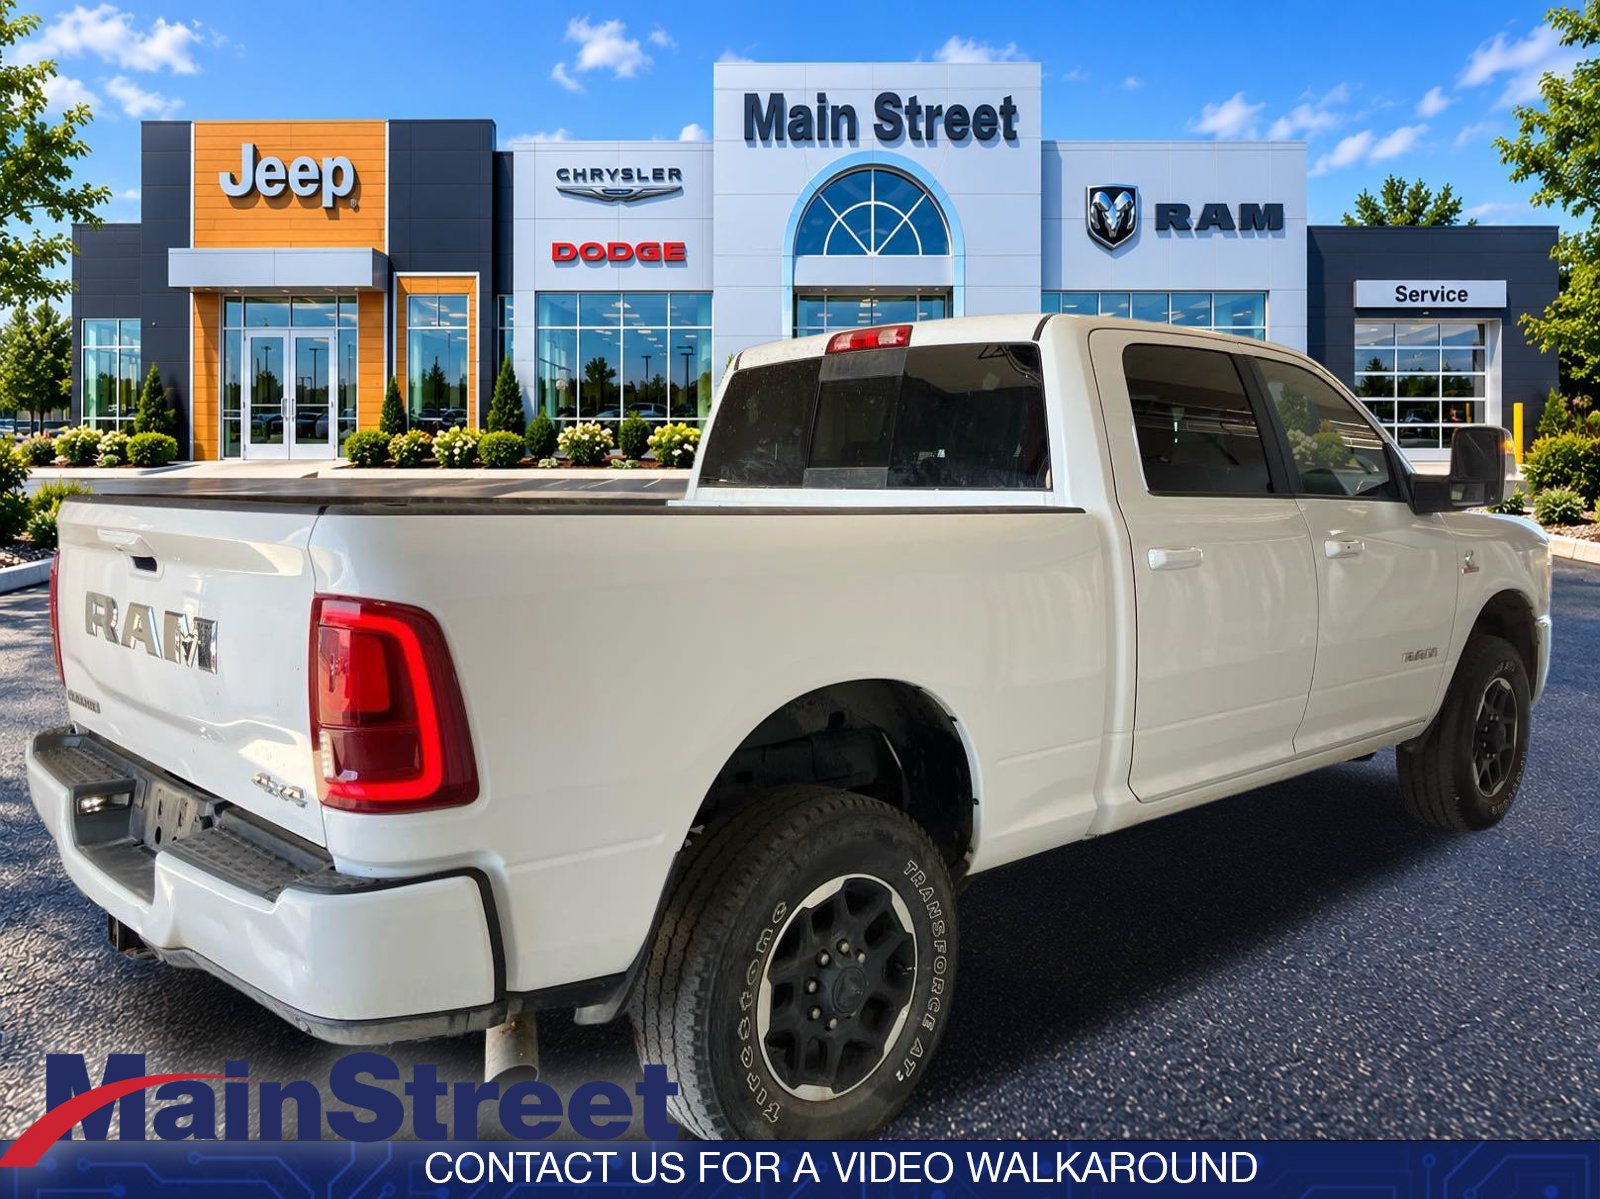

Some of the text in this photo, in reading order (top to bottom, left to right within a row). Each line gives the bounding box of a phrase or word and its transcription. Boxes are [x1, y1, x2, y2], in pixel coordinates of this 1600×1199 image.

[743, 91, 1018, 142] Main Street
[218, 142, 355, 208] Jeep
[555, 167, 683, 183] CHRYSLER
[1155, 203, 1284, 231] RAM
[551, 241, 686, 263] DODGE
[1394, 285, 1469, 303] Service
[85, 590, 218, 675] RAM
[903, 859, 948, 1032] TRANSFORCE
